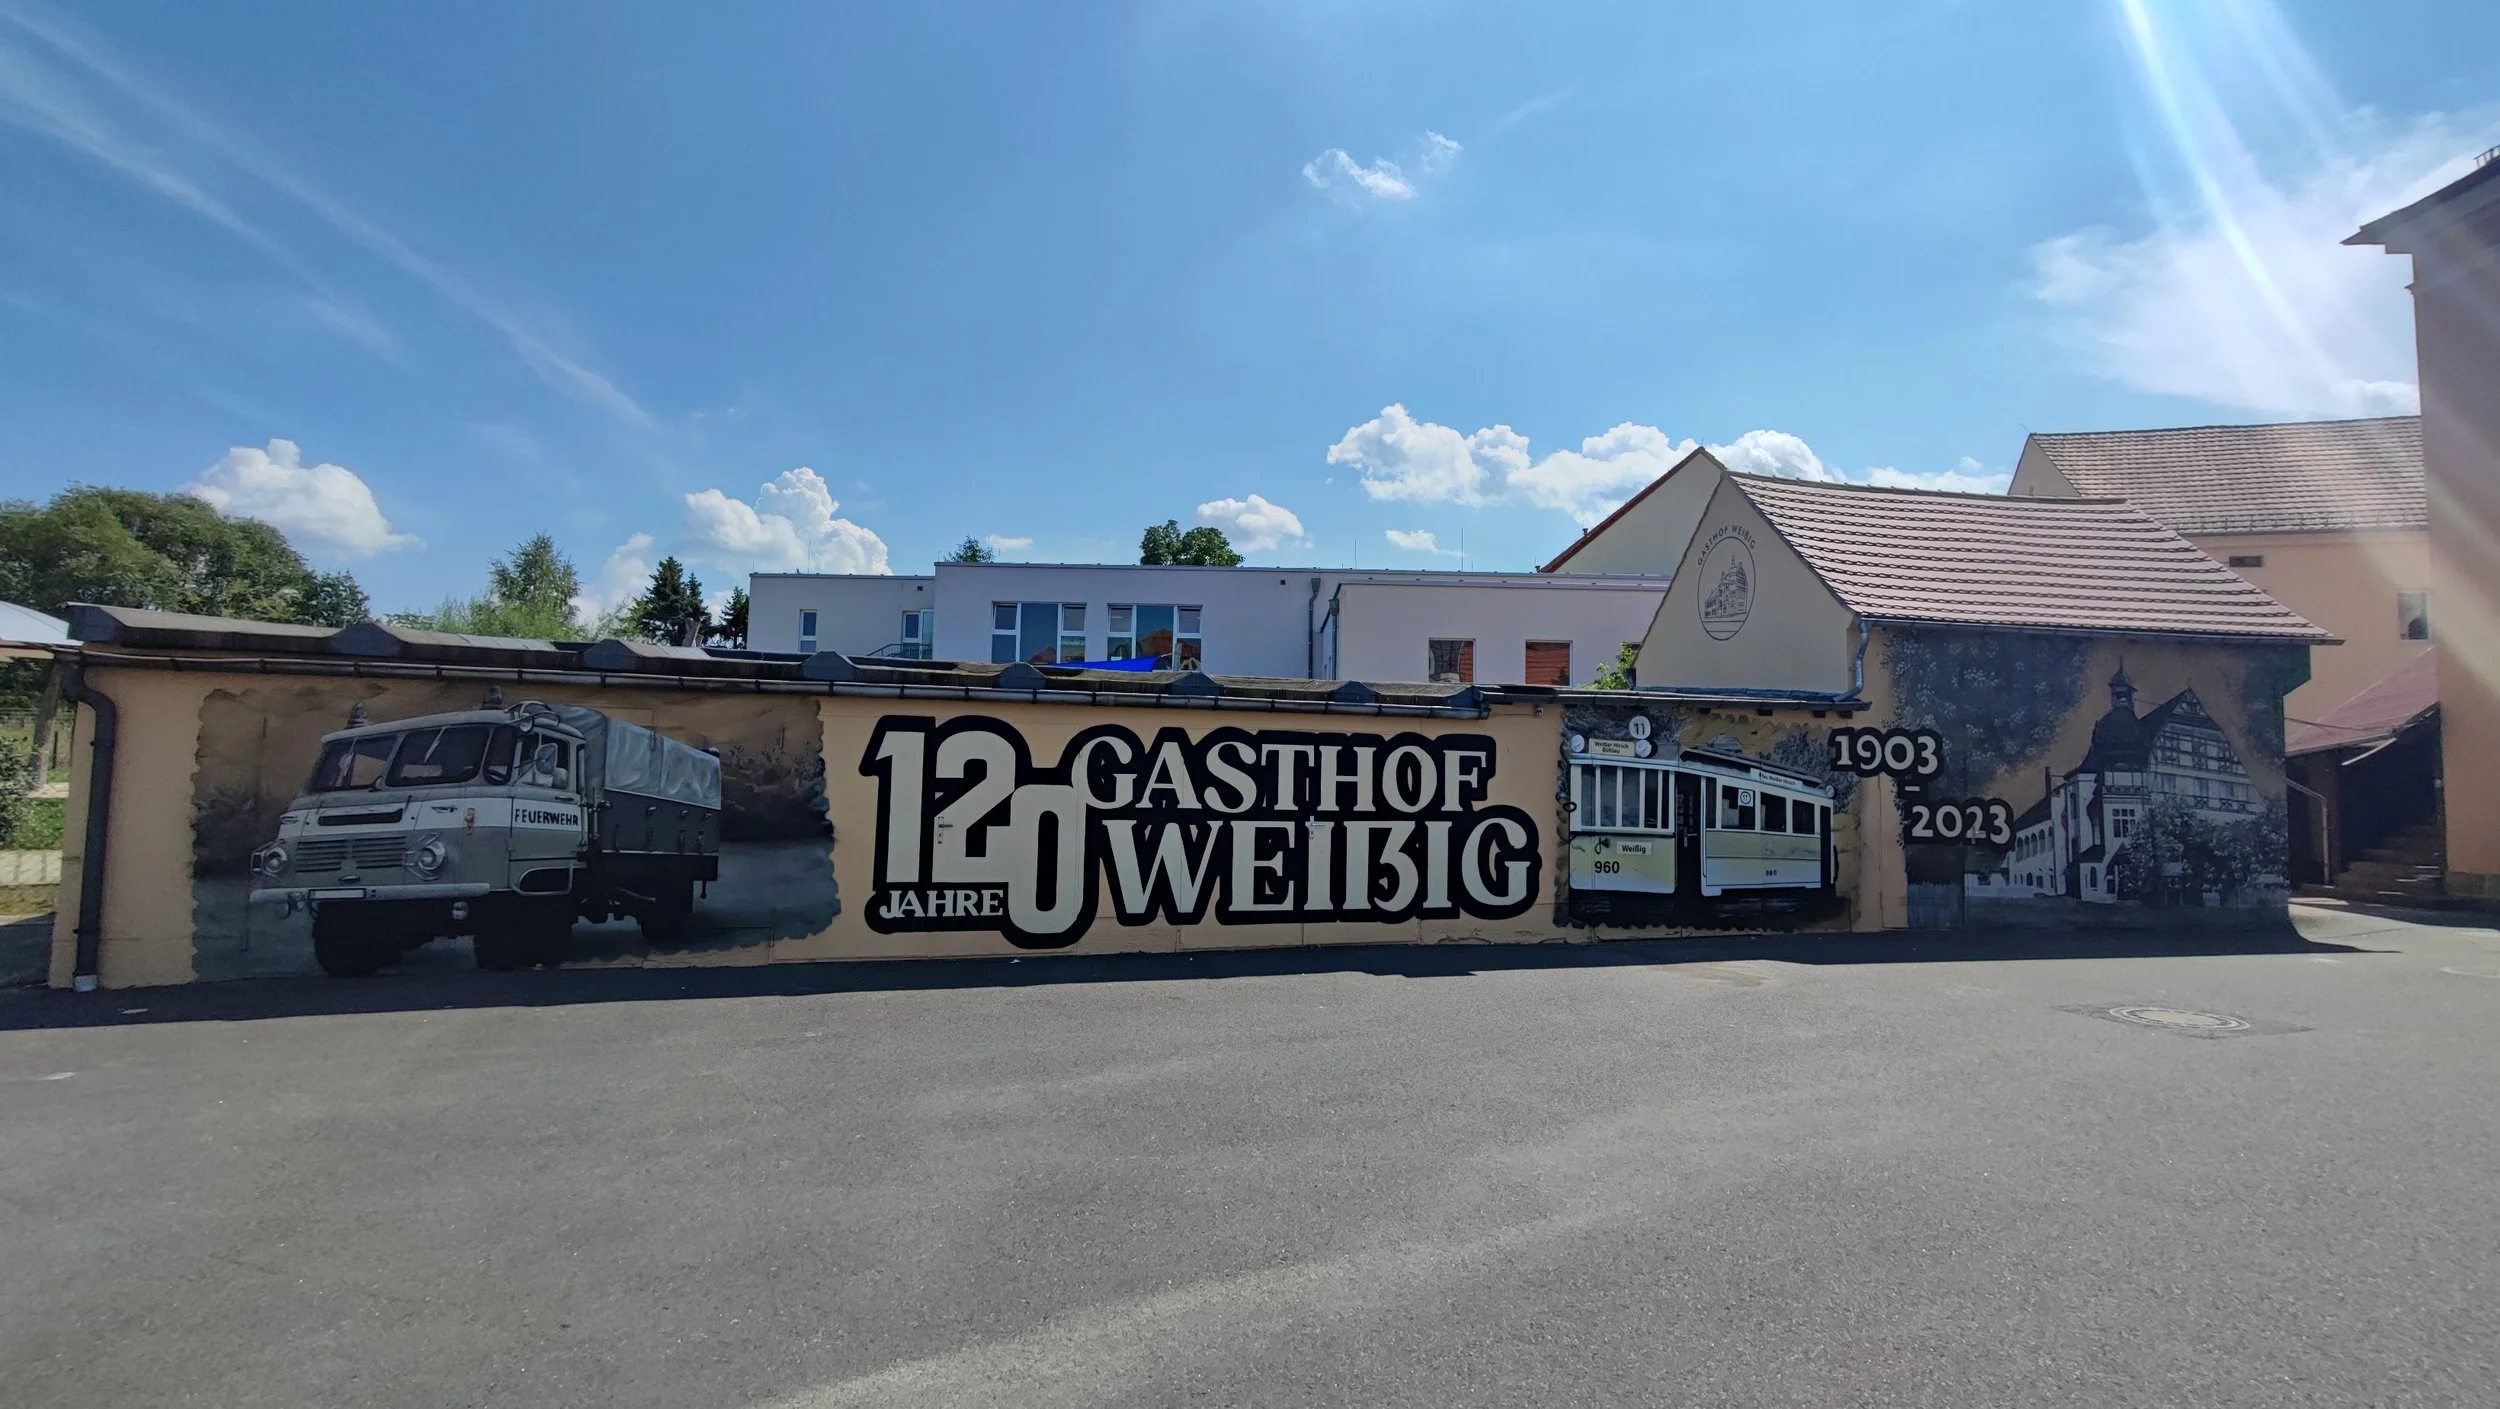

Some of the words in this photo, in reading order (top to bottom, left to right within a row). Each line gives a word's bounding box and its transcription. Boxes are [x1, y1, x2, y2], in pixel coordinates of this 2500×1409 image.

[1697, 525, 1729, 566] GASTHOF
[1633, 722, 1645, 735] 11
[1835, 735, 1938, 774] 1903
[1071, 736, 1487, 813] GASTHOF
[515, 808, 579, 826] FEUERWEHR
[875, 730, 1086, 933] 120
[1911, 805, 2011, 844] 2023
[1622, 844, 1647, 854] Weißig
[1594, 860, 1620, 873] 960
[879, 889, 1004, 919] JAHRE
